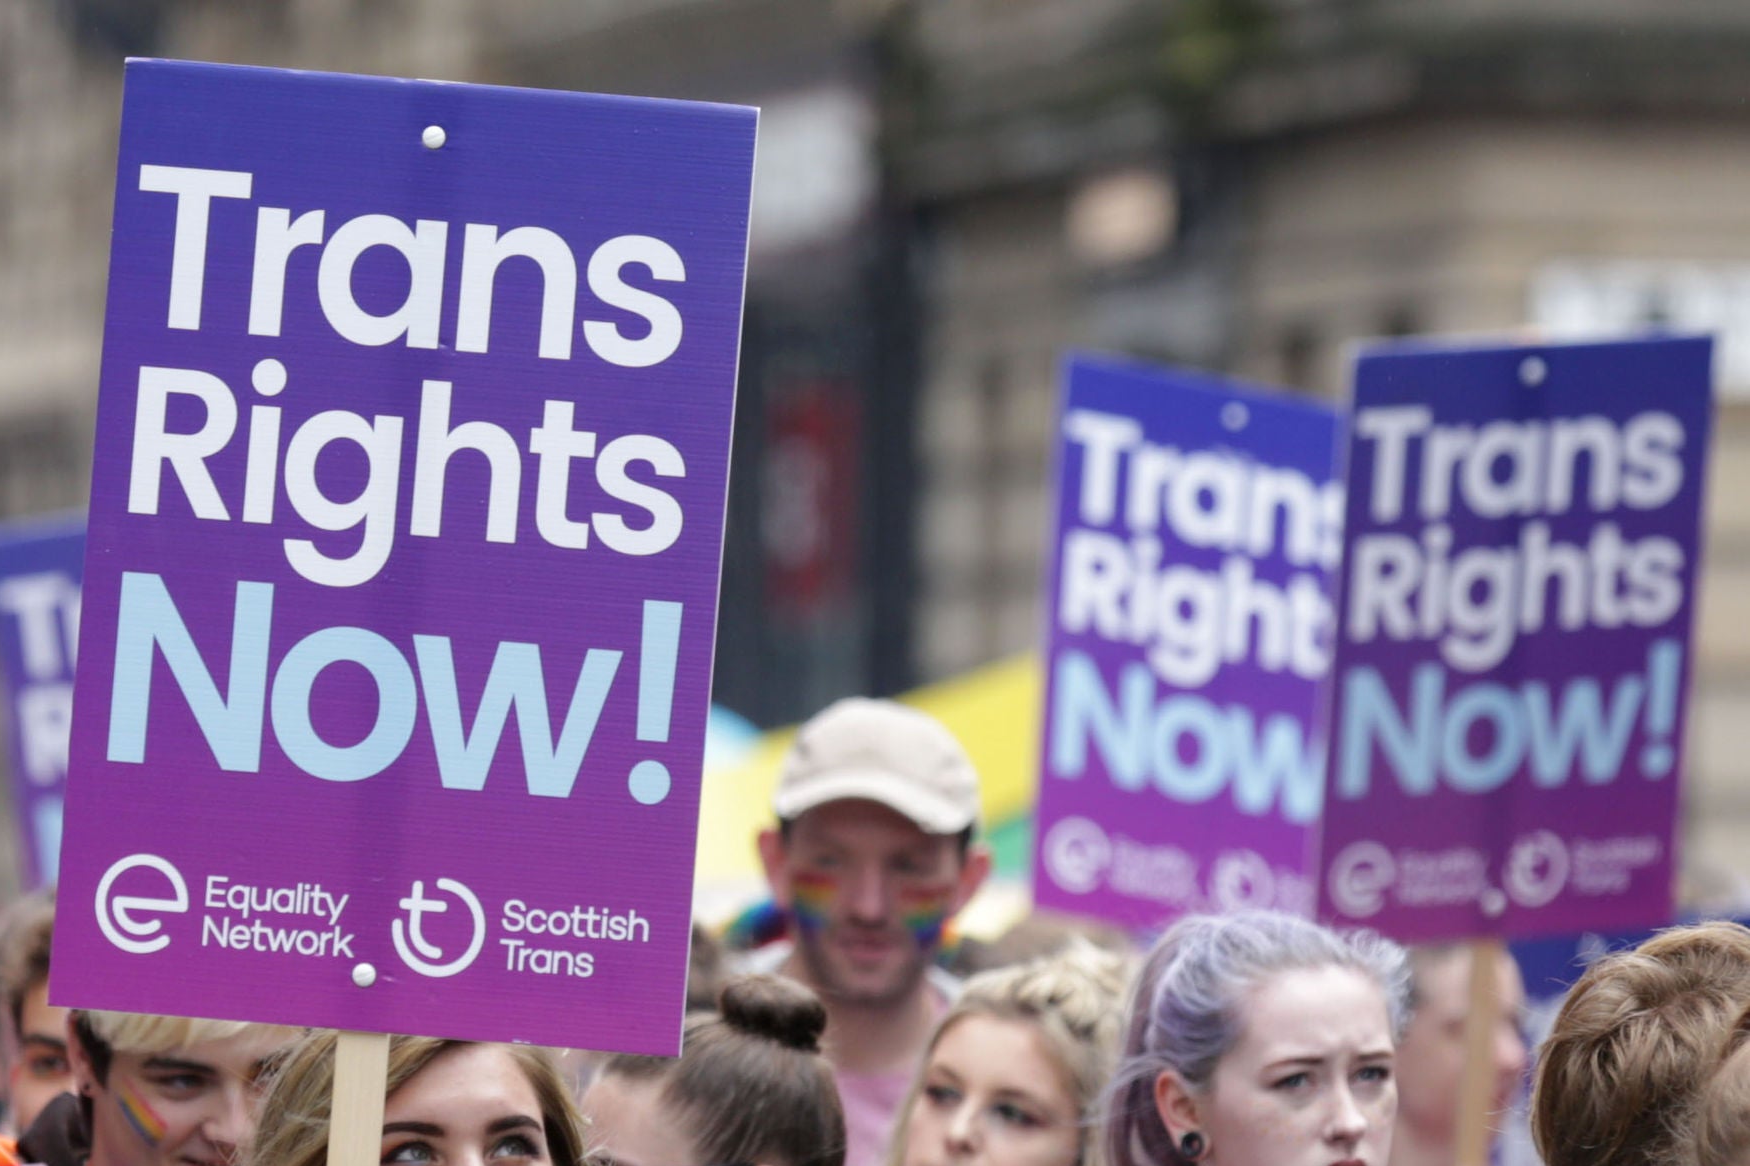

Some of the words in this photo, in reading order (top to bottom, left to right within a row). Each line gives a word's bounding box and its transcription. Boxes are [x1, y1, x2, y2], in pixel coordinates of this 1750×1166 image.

[139, 164, 686, 367] Trans
[127, 358, 686, 587] Rights
[1356, 405, 1684, 524] Trans
[1060, 530, 1335, 688] Right
[1351, 522, 1685, 673] Rights
[106, 571, 683, 804] Now!
[1338, 639, 1681, 800] Now!
[202, 915, 354, 958] Network
[205, 875, 349, 925] Equality
[500, 939, 594, 977] Trans
[501, 899, 650, 942] Scottish
